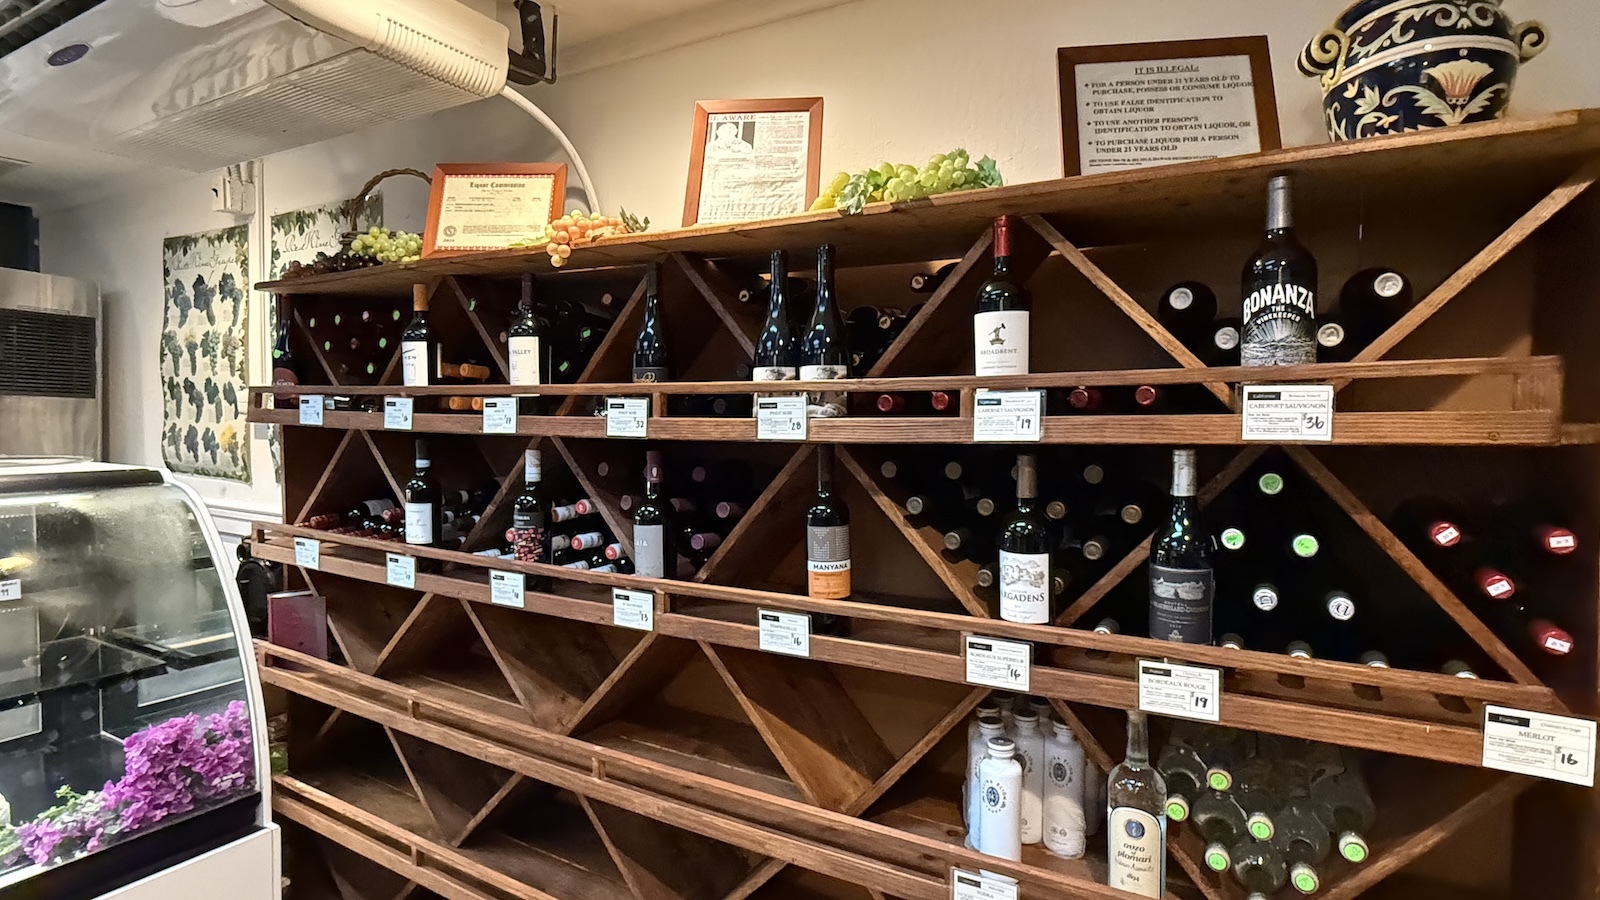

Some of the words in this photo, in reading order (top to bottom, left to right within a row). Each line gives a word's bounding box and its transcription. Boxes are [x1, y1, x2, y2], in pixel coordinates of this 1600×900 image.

[1135, 67, 1144, 75] IT
[1146, 66, 1155, 74] IS
[1156, 64, 1199, 74] ILLEGAL:
[1182, 83, 1221, 91] CONSUME
[1146, 96, 1210, 105] IDENTIFICATION
[1093, 107, 1122, 115] OBTAIN
[1124, 106, 1155, 114] LIQUOR
[1094, 125, 1158, 134] IDENTIFICATION
[1172, 123, 1202, 131] OBTAIN
[1204, 121, 1238, 129] LIQUOR,
[1107, 138, 1149, 146] PURCHASE
[1150, 136, 1181, 144] LIQUOR
[1208, 134, 1240, 142] PERSON
[1243, 283, 1315, 325] BONANZA
[977, 406, 1004, 414] CABERNET
[813, 563, 848, 571] MANYANA
[1148, 678, 1183, 688] BORDEAUX
[1183, 682, 1207, 691] ROUGE
[1518, 731, 1556, 742] MERLOT
[1117, 850, 1152, 863] plomari
